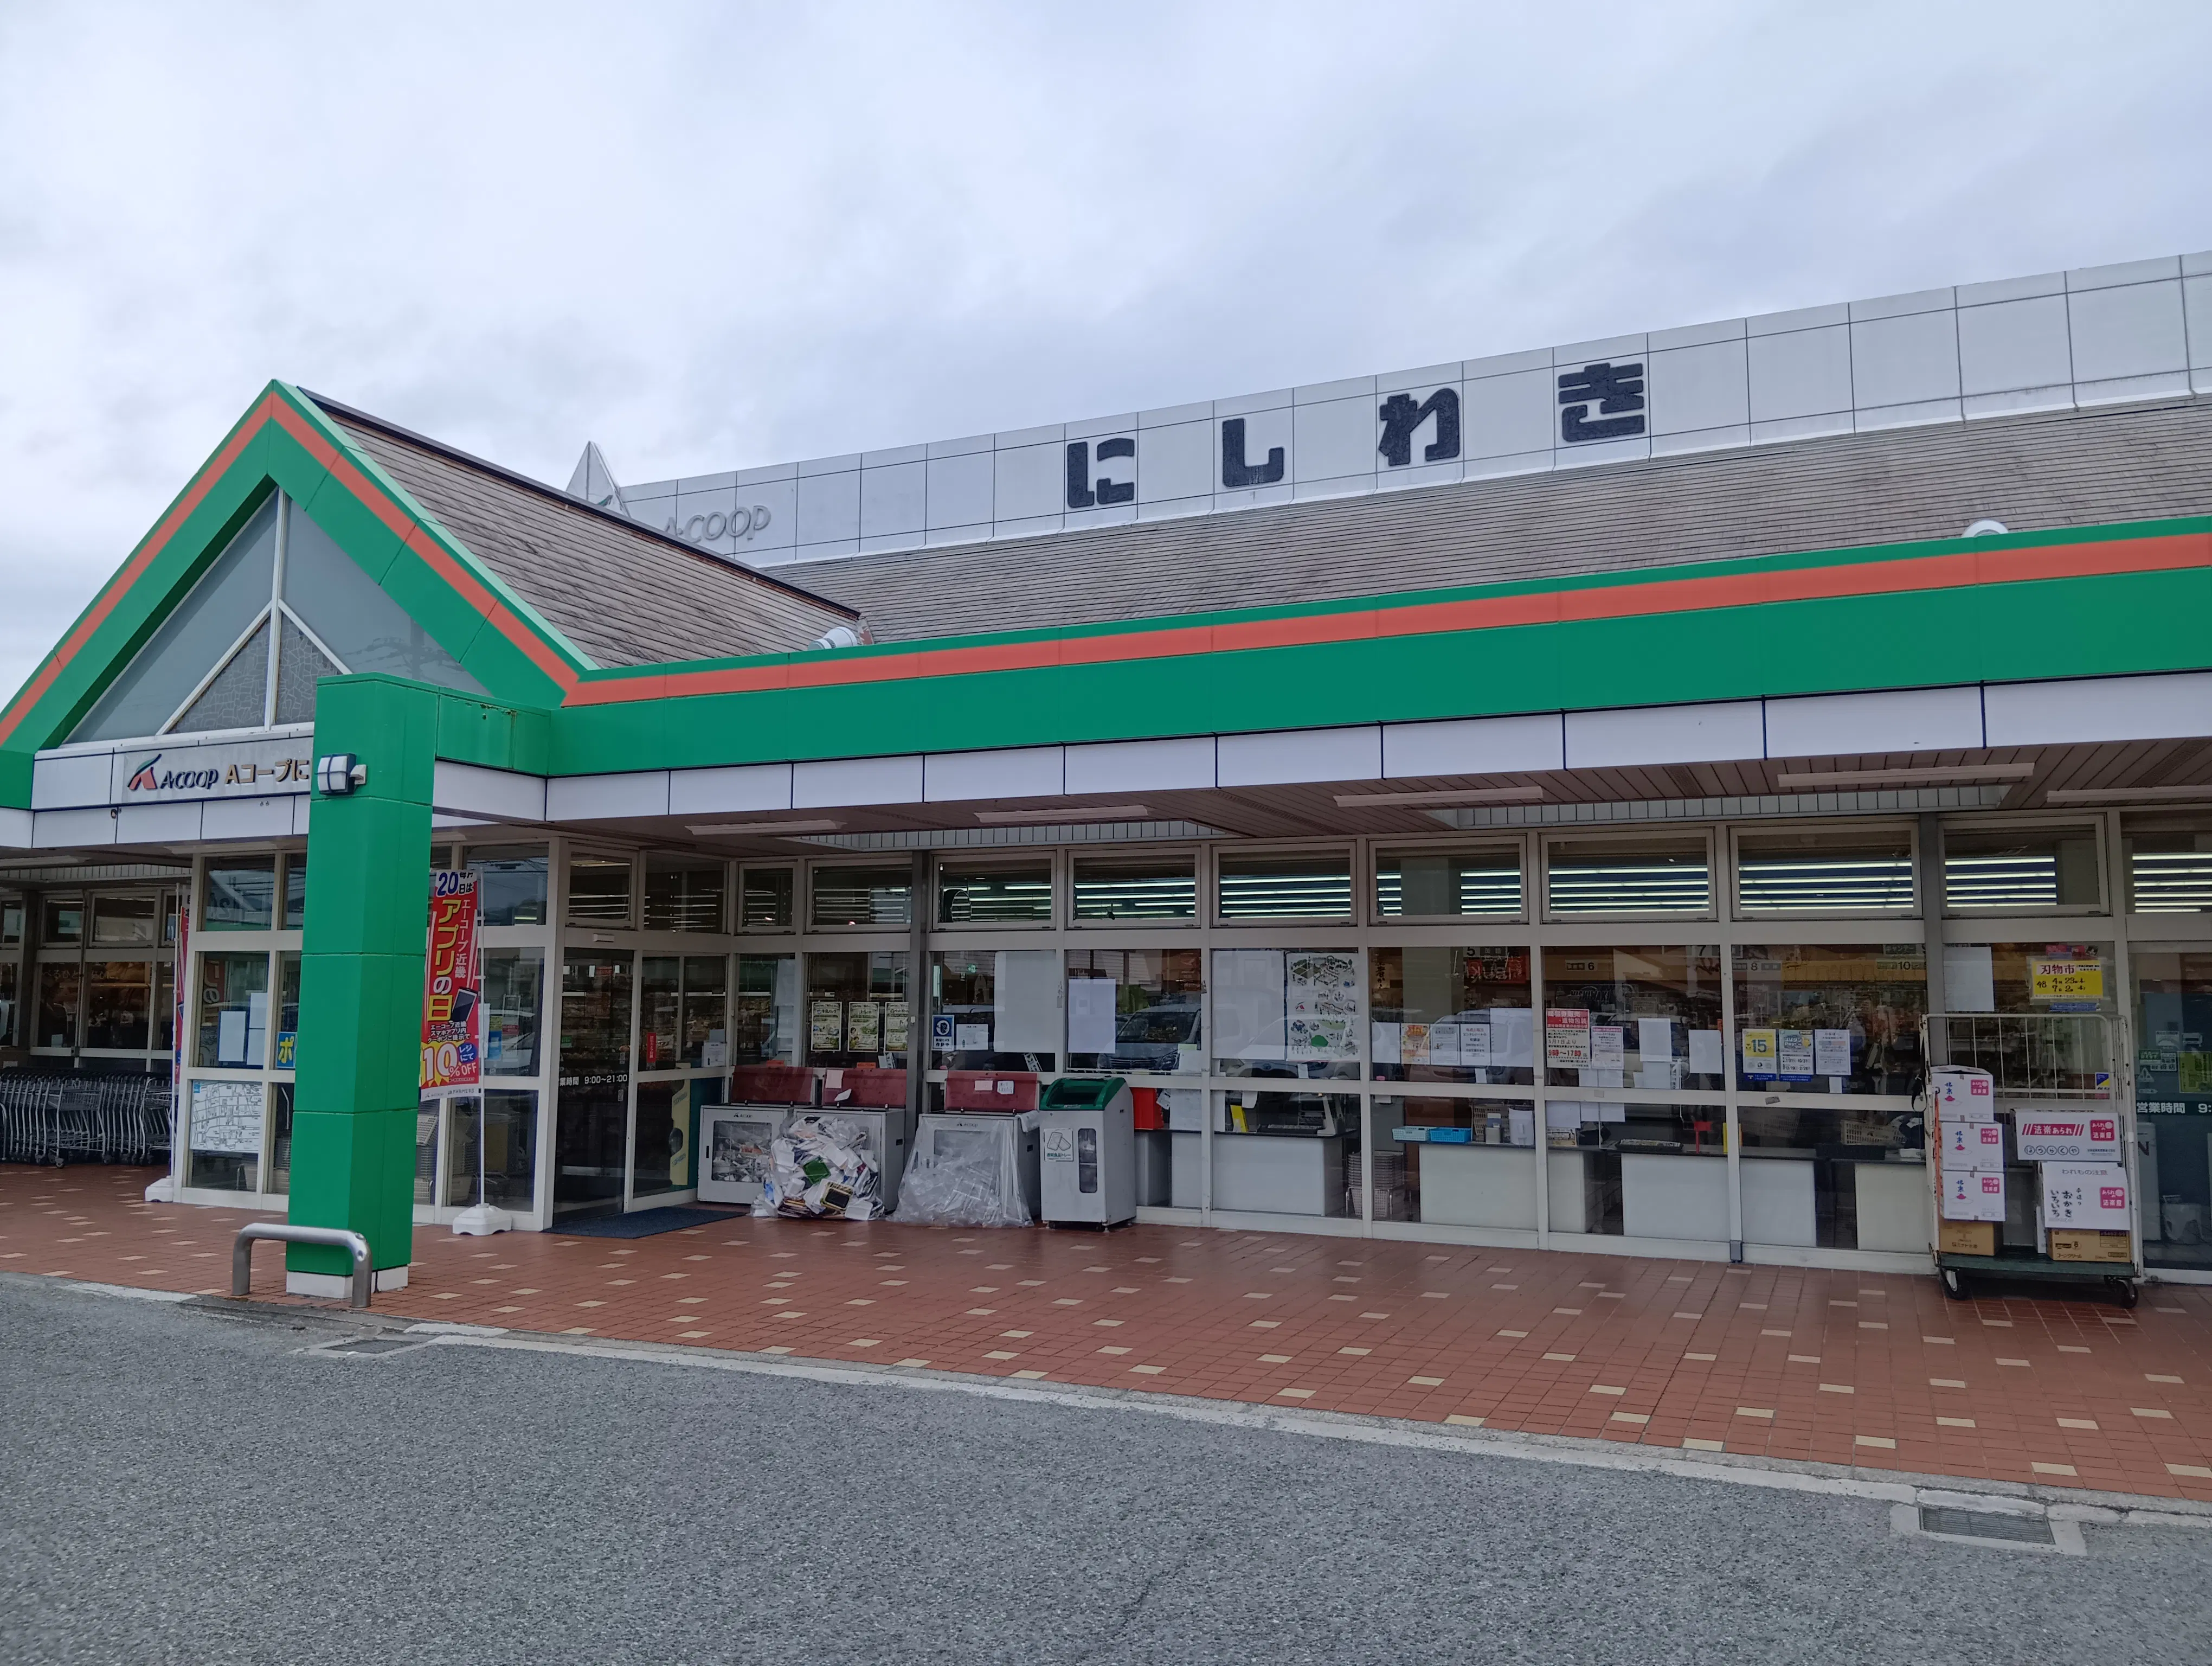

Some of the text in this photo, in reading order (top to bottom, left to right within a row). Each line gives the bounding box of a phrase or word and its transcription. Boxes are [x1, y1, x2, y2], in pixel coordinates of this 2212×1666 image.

[1067, 362, 1645, 508] にしわき
[437, 872, 459, 896] 20
[454, 899, 471, 978] エーコープ近畿
[1467, 947, 1475, 956] 5
[1699, 945, 1707, 956] 7
[428, 899, 461, 1021] アプリの日
[1588, 962, 1594, 970] 6
[1751, 962, 1758, 971] 8
[1898, 962, 1911, 970] 10
[2040, 964, 2075, 975] 刃物市
[430, 1021, 467, 1030] エーコープ近畿
[279, 1036, 295, 1064] ポ
[459, 1045, 472, 1053] レジ
[1751, 1039, 1767, 1053] 15
[460, 1053, 474, 1062] にて
[2137, 1102, 2185, 1114] 営業時間
[2034, 1125, 2073, 1135] 法楽あられ
[2050, 1189, 2060, 1217] いろいろ
[2062, 1190, 2073, 1218] おかき
